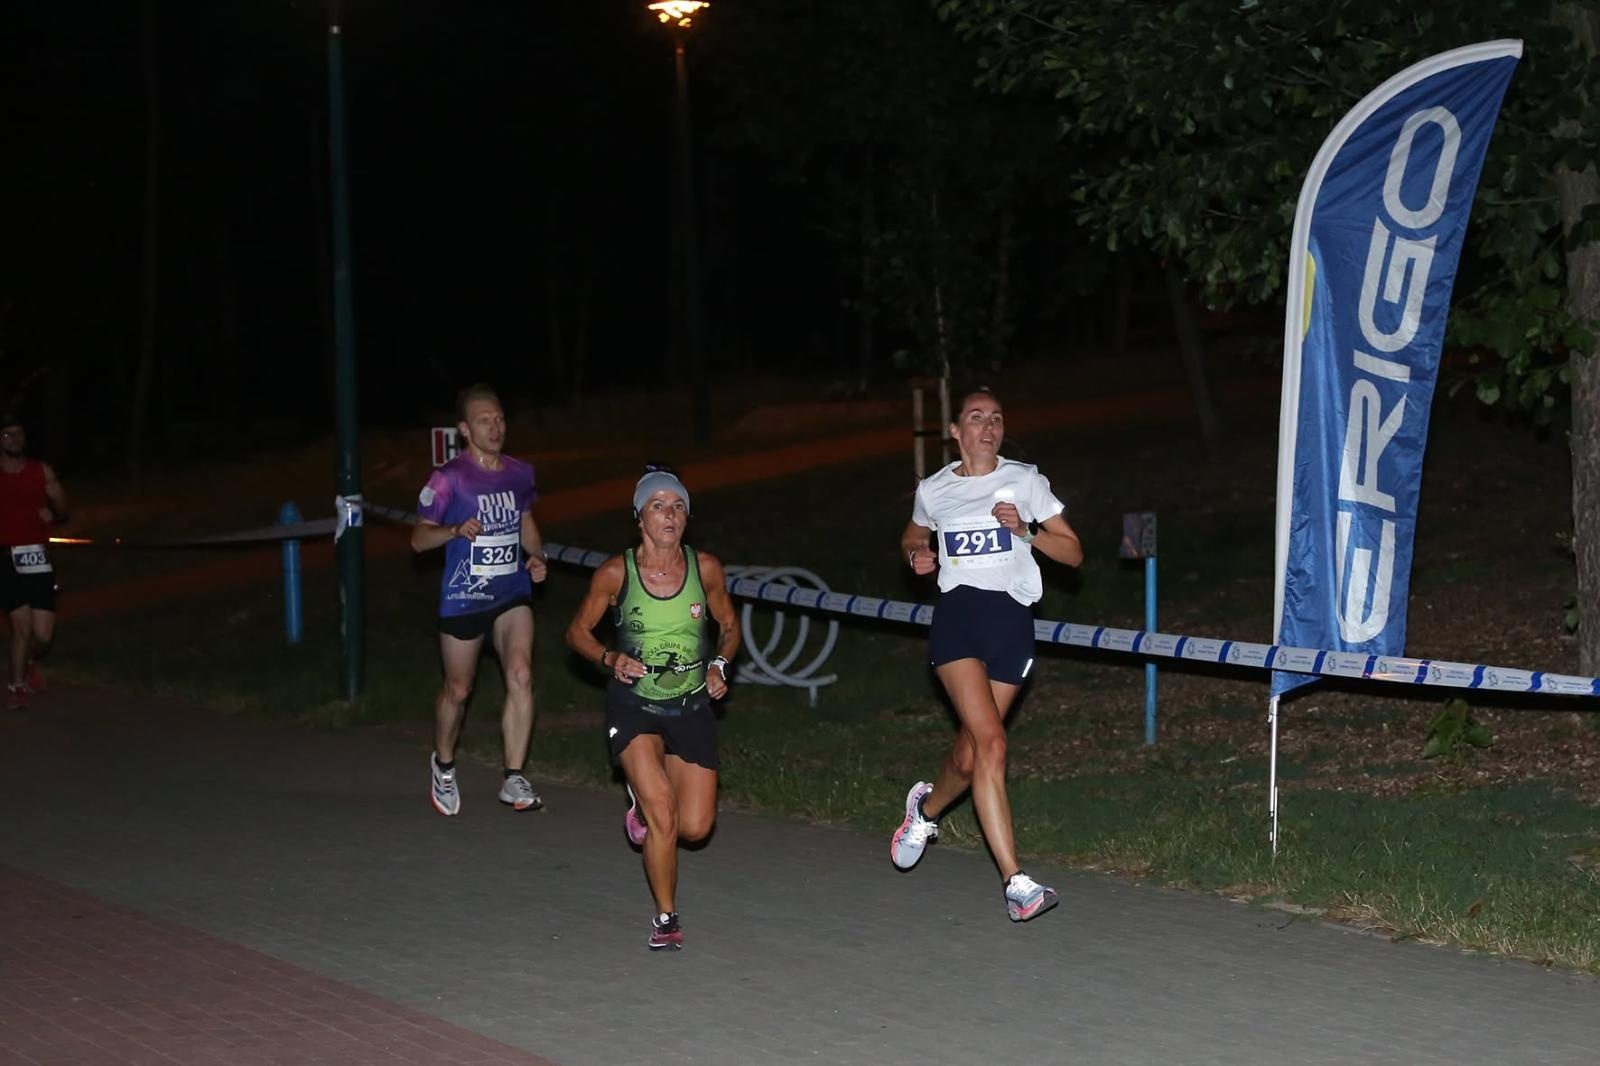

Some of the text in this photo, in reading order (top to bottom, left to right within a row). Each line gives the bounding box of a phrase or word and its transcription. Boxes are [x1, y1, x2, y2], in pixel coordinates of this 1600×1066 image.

[1336, 105, 1463, 644] ERIGO
[477, 490, 521, 524] RUN
[954, 530, 1002, 555] 291
[20, 551, 46, 566] 403
[481, 545, 514, 566] 326
